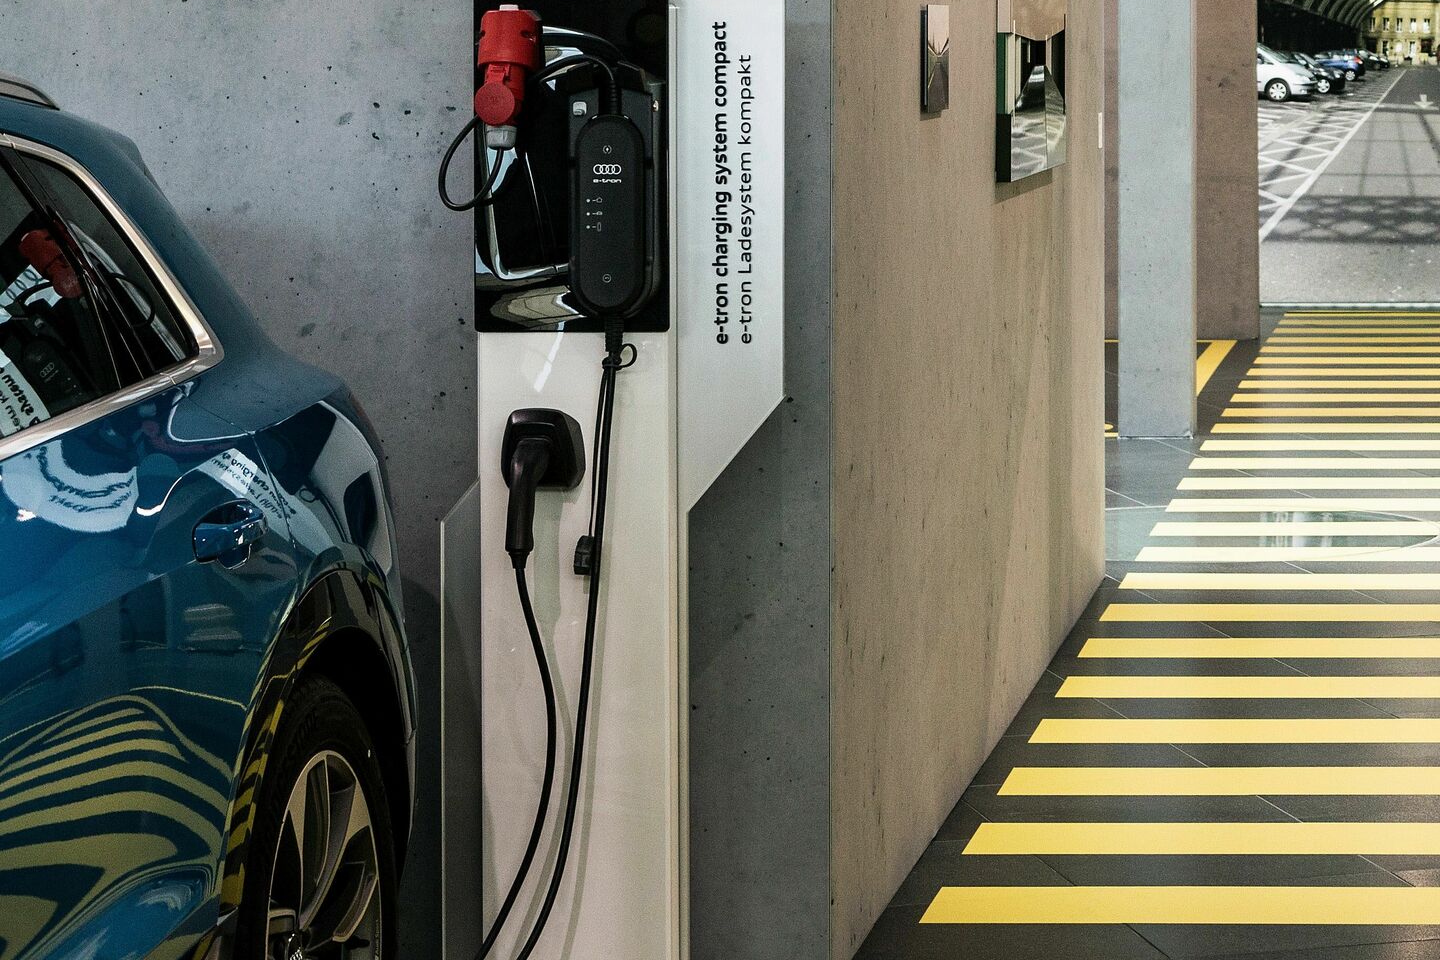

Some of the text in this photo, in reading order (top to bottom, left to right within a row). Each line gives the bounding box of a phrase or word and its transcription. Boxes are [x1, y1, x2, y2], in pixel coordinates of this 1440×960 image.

[711, 21, 733, 345] e-tron charging system compact
[737, 54, 756, 345] e-tron Ladesystem kompakt
